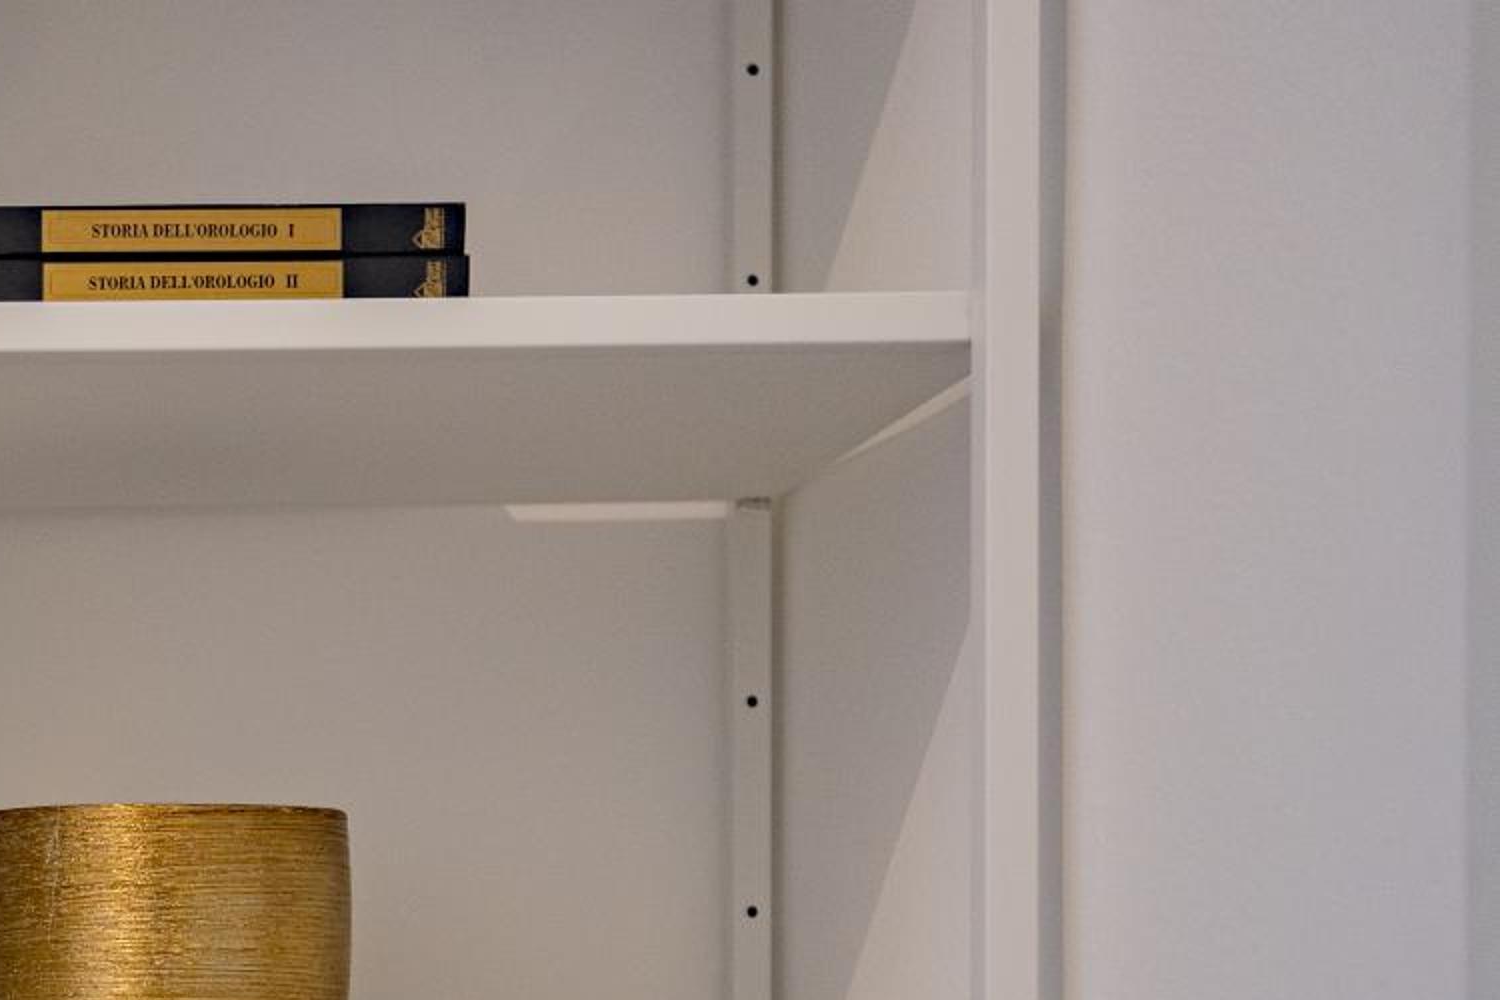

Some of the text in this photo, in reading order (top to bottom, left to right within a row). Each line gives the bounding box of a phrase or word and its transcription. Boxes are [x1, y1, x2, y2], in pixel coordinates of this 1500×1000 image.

[90, 222, 295, 239] STORIA DELL'OROLOGIO I
[88, 274, 298, 291] STORIA DELL'OROLOGIO II
